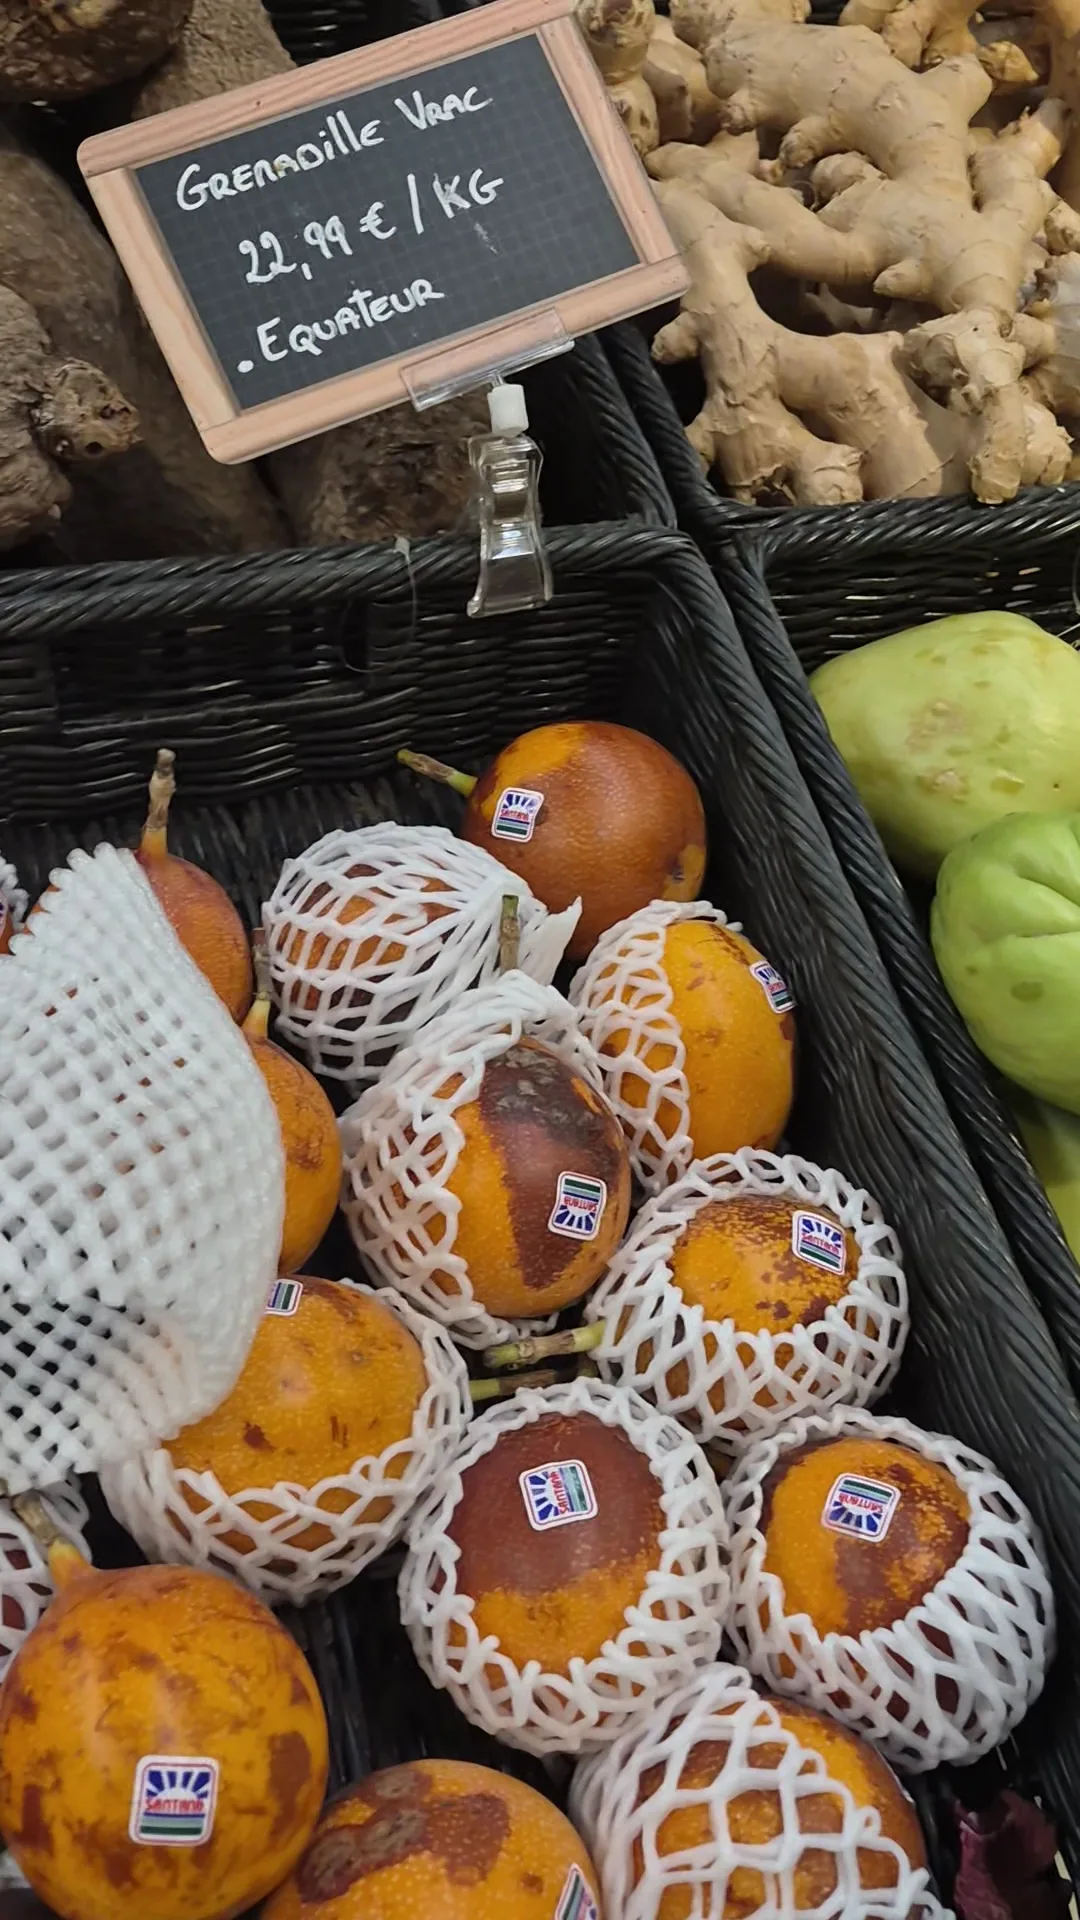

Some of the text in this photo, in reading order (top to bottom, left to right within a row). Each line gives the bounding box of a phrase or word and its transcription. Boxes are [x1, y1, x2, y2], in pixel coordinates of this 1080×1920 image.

[238, 215, 353, 283] 22,99
[433, 168, 504, 219] KG
[801, 1232, 842, 1254] SANTANA
[551, 1471, 570, 1514] SANTANA
[839, 1491, 885, 1514] SANTANA
[145, 1798, 205, 1812] SANTANA
